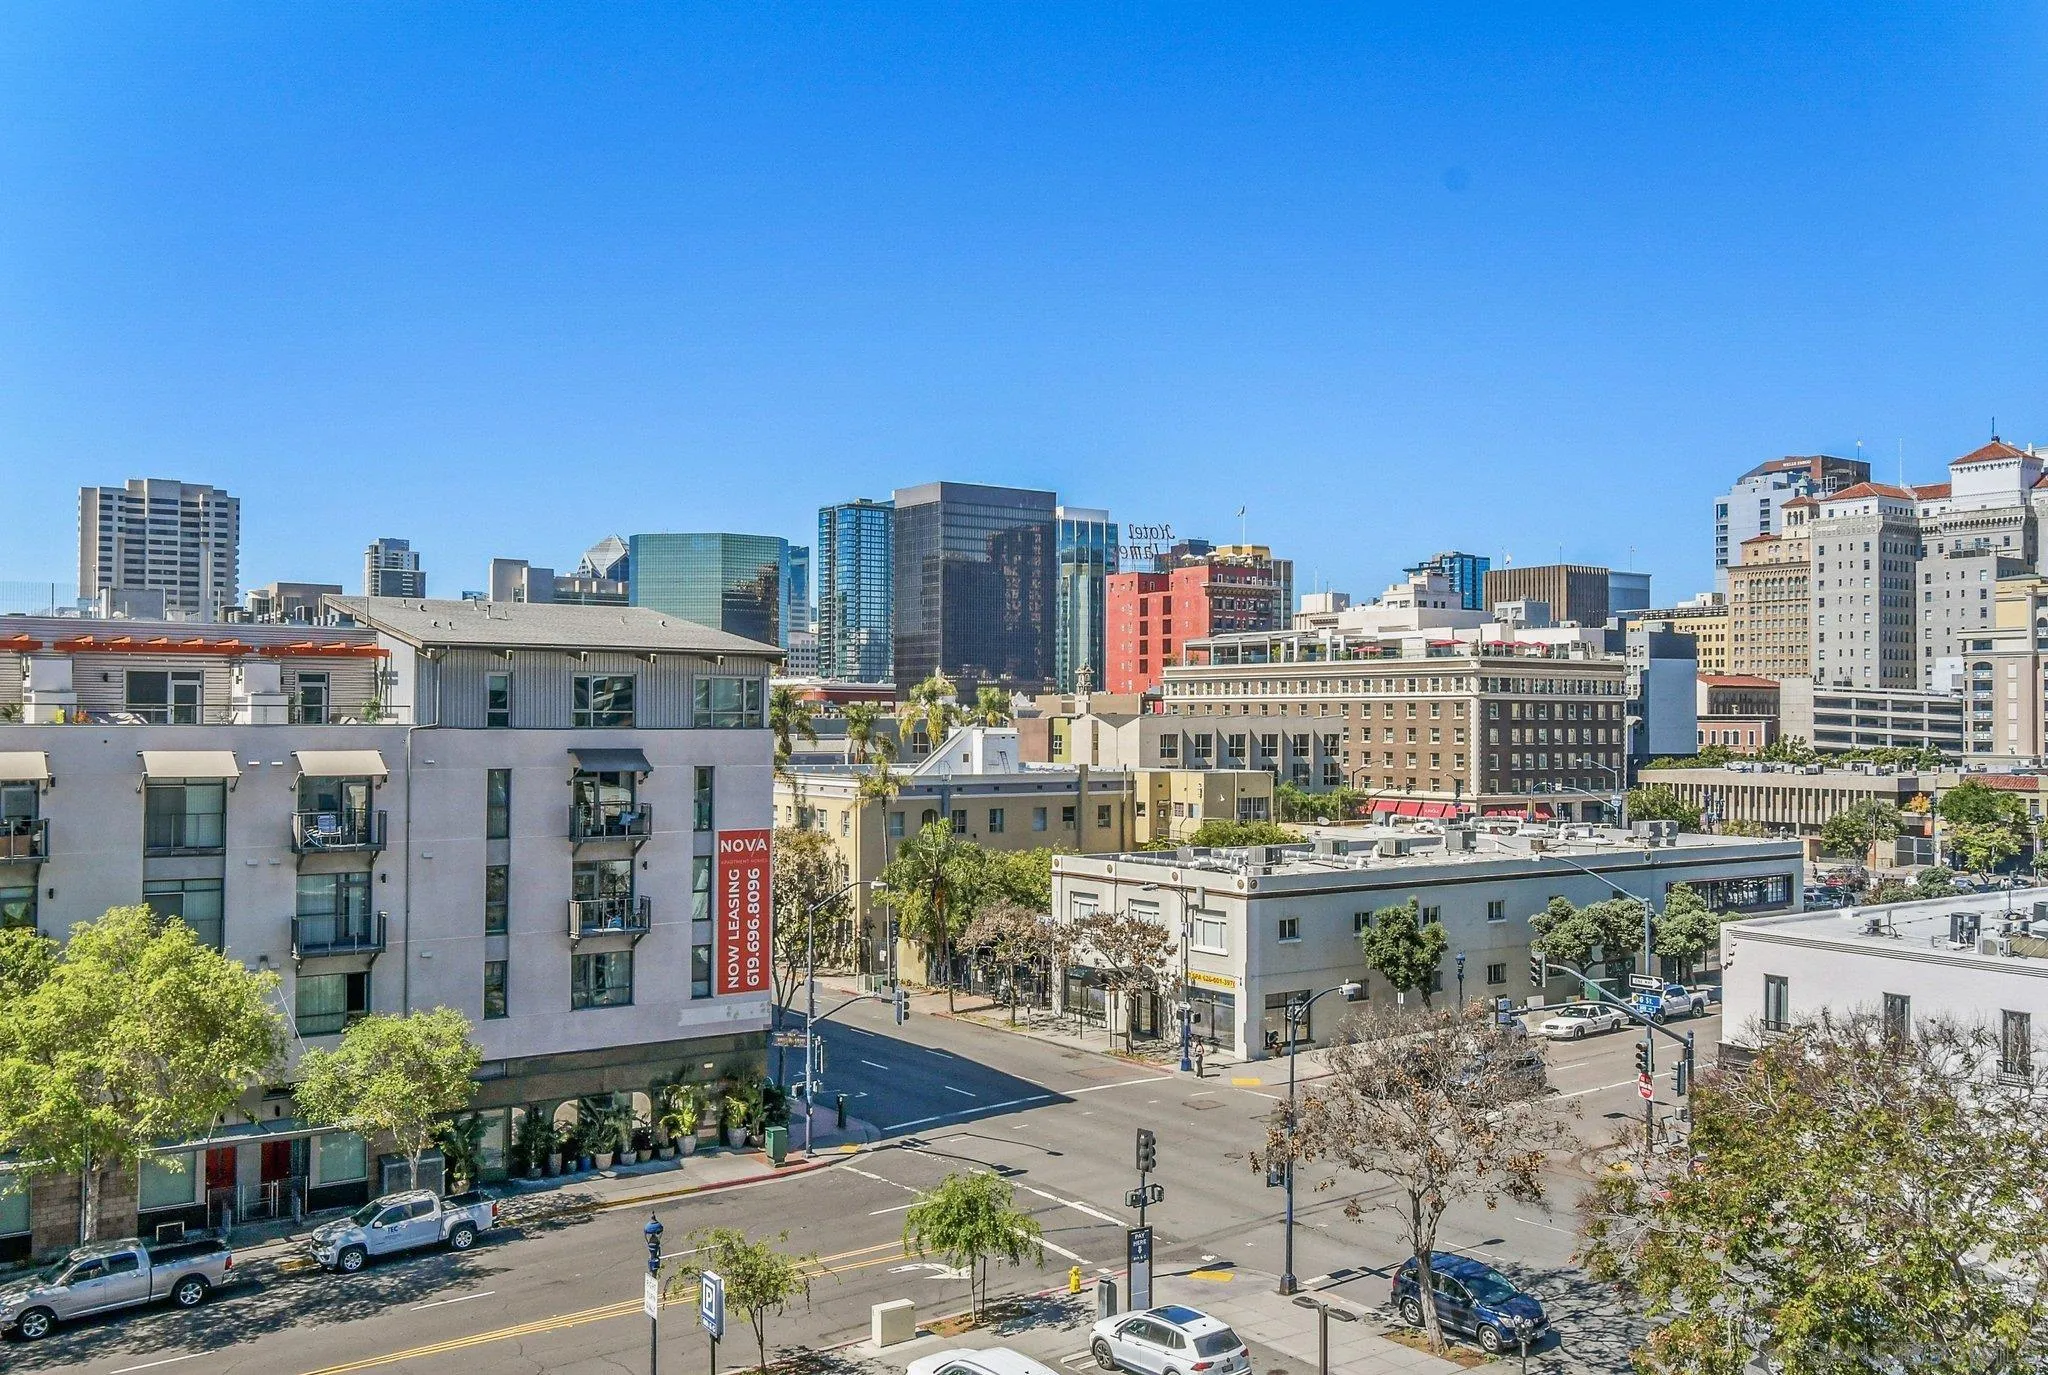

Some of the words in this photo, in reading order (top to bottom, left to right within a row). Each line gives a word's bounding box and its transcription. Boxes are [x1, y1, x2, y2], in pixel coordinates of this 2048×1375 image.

[720, 838, 768, 853] NOVA
[728, 869, 740, 940] LEASING
[746, 867, 760, 987] 619.696.8096
[728, 945, 740, 989] NOW
[705, 1285, 714, 1310] P
